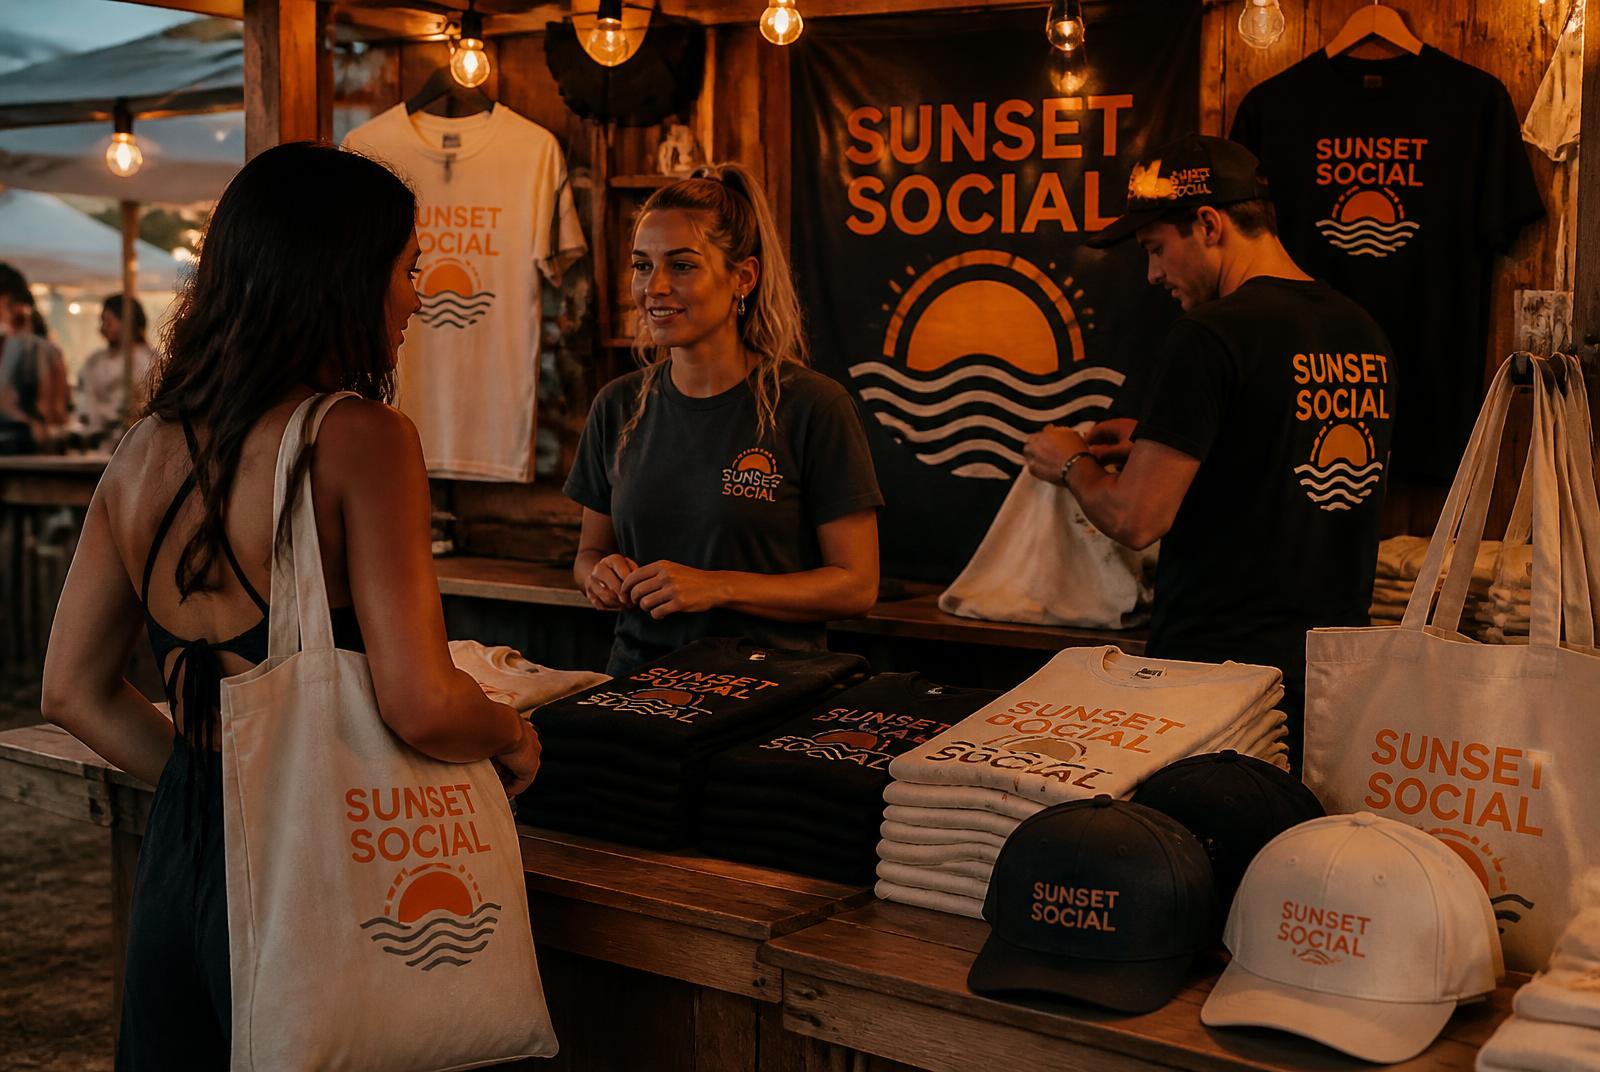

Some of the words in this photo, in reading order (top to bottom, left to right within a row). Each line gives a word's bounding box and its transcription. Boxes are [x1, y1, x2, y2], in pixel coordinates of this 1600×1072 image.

[844, 94, 1134, 165] SUNSET
[1315, 137, 1429, 160] SUNSET
[1315, 161, 1425, 187] SOCIAL
[415, 206, 502, 228] UNSET
[845, 170, 1125, 236] SOCIAL
[418, 232, 500, 256] OCIAL
[1292, 353, 1388, 384] SUNSET
[1295, 388, 1391, 421] SOCIAL
[721, 483, 777, 503] SOCIAL
[1008, 701, 1186, 735] SUNSET
[1371, 728, 1553, 790] SUNSET
[345, 784, 476, 822] SUNSET
[1364, 771, 1544, 837] SOCIAL
[351, 821, 491, 863] SOCIAL
[1032, 881, 1120, 910] SUNSET
[1031, 902, 1117, 932] SOCIAL
[1282, 901, 1372, 935] SUNSET
[1278, 922, 1366, 958] SOCIAL
